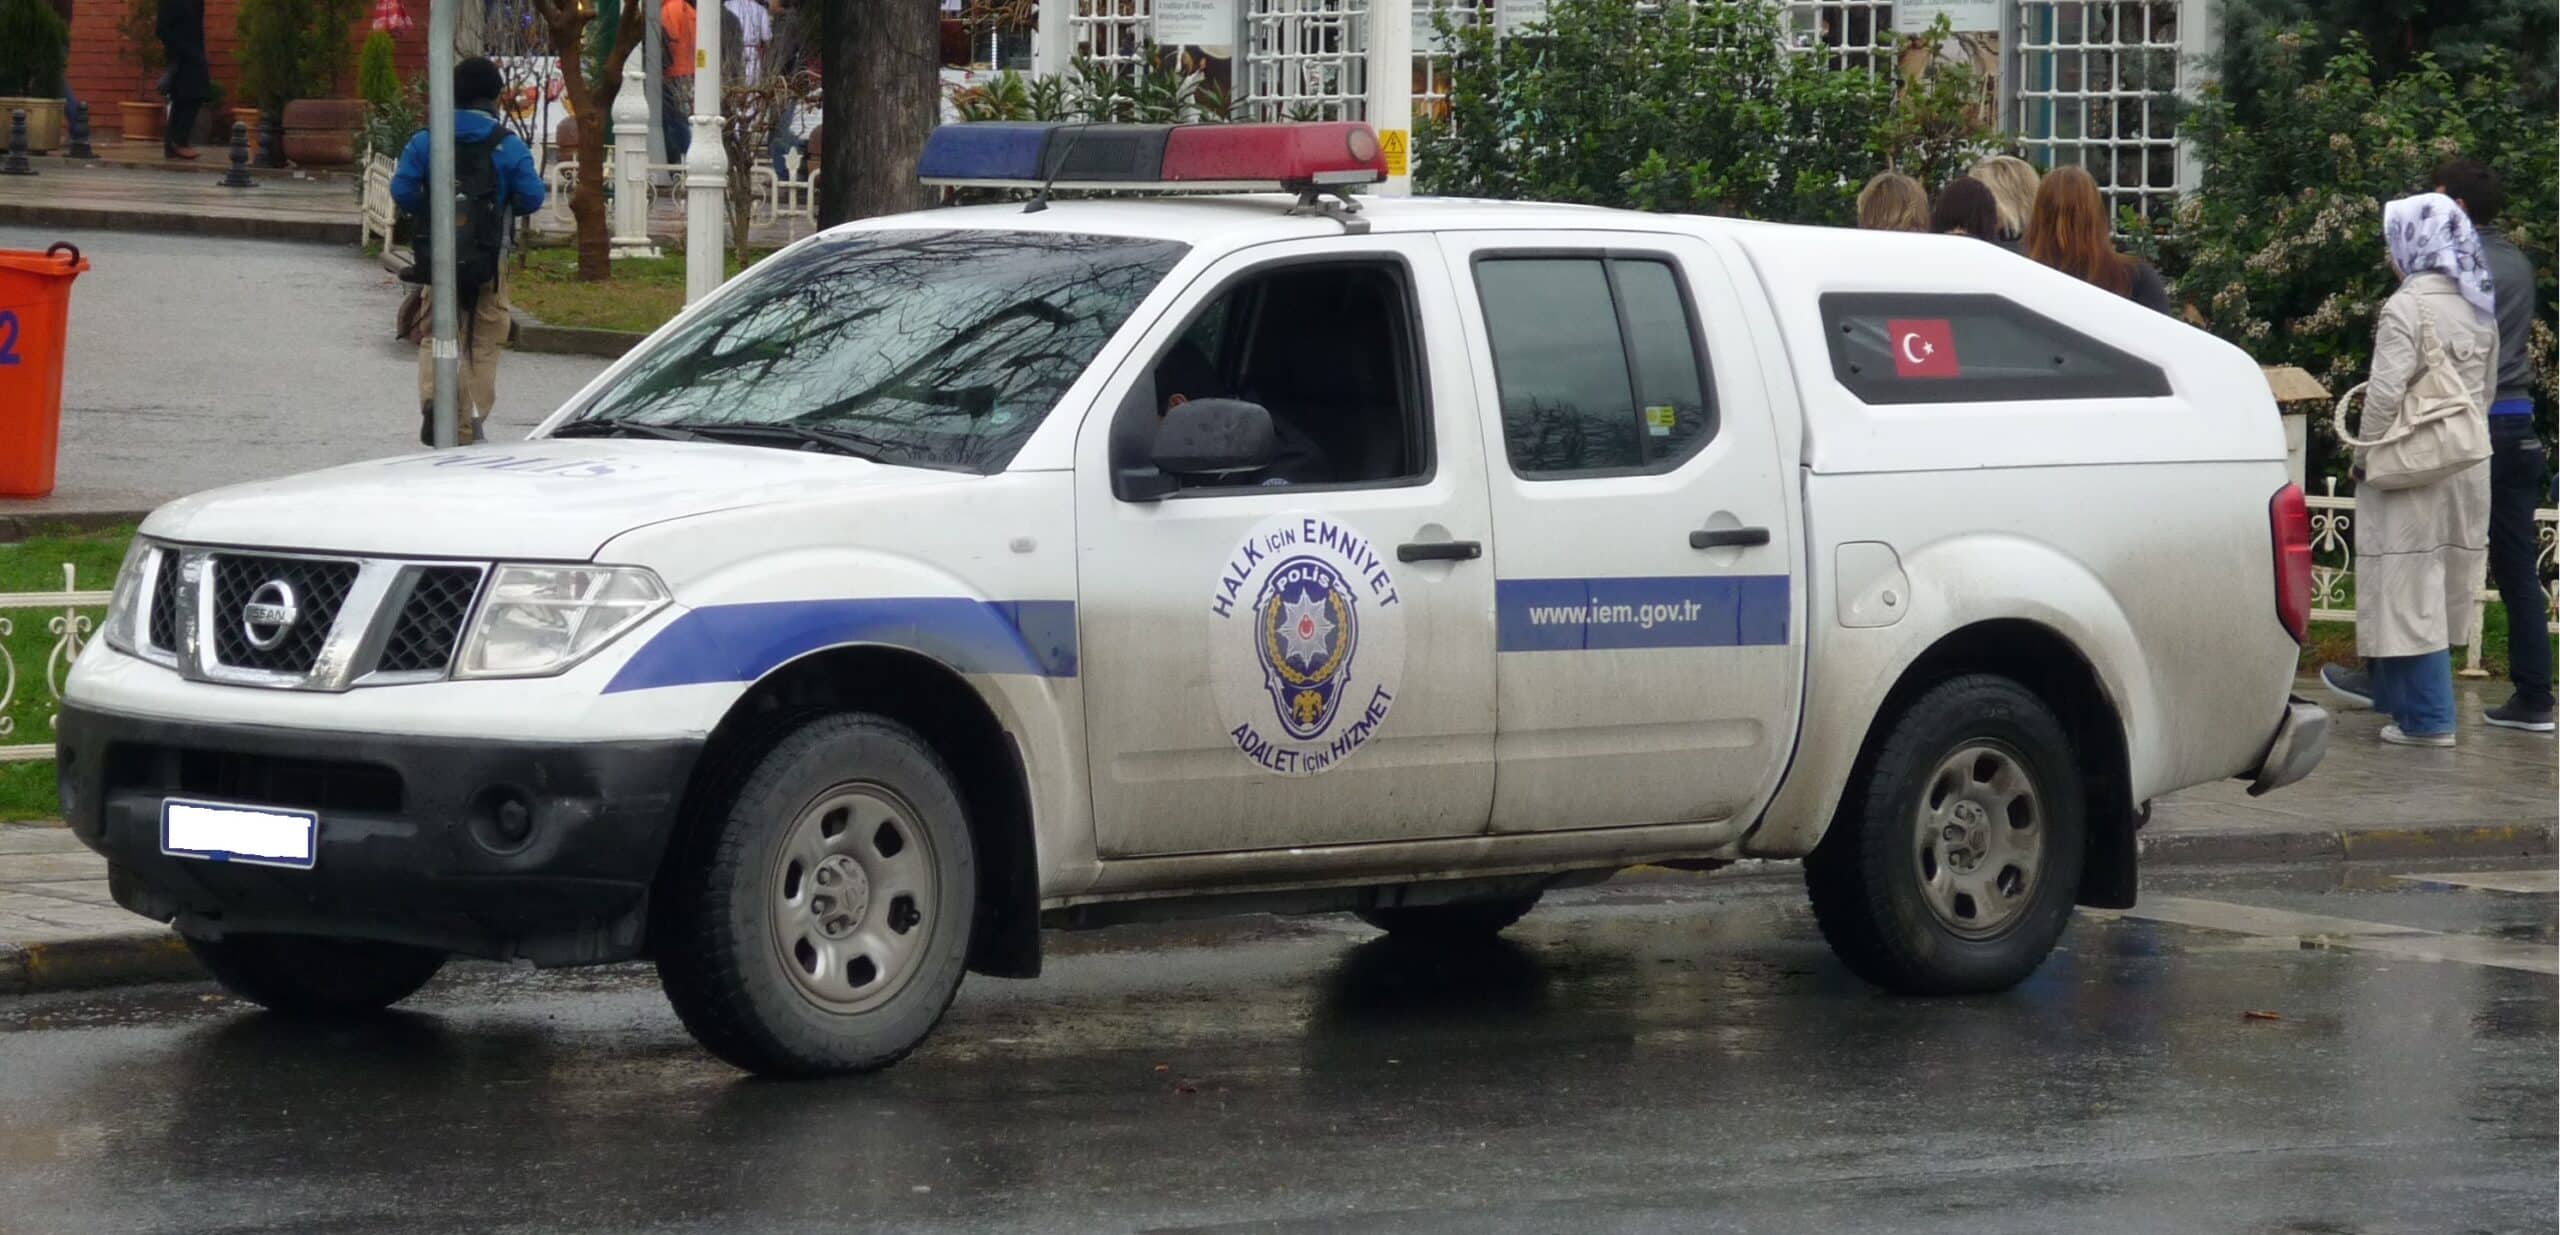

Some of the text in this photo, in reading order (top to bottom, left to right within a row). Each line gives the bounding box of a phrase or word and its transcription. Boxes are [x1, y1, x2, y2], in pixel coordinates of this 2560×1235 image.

[1213, 538, 1264, 619] HALK
[1303, 519, 1399, 608] EMNİYET
[1277, 566, 1329, 592] POLİS
[1529, 597, 1701, 628] www.iem.gov.tr
[1231, 723, 1299, 773] ADALET
[1330, 684, 1393, 761] HİZMET
